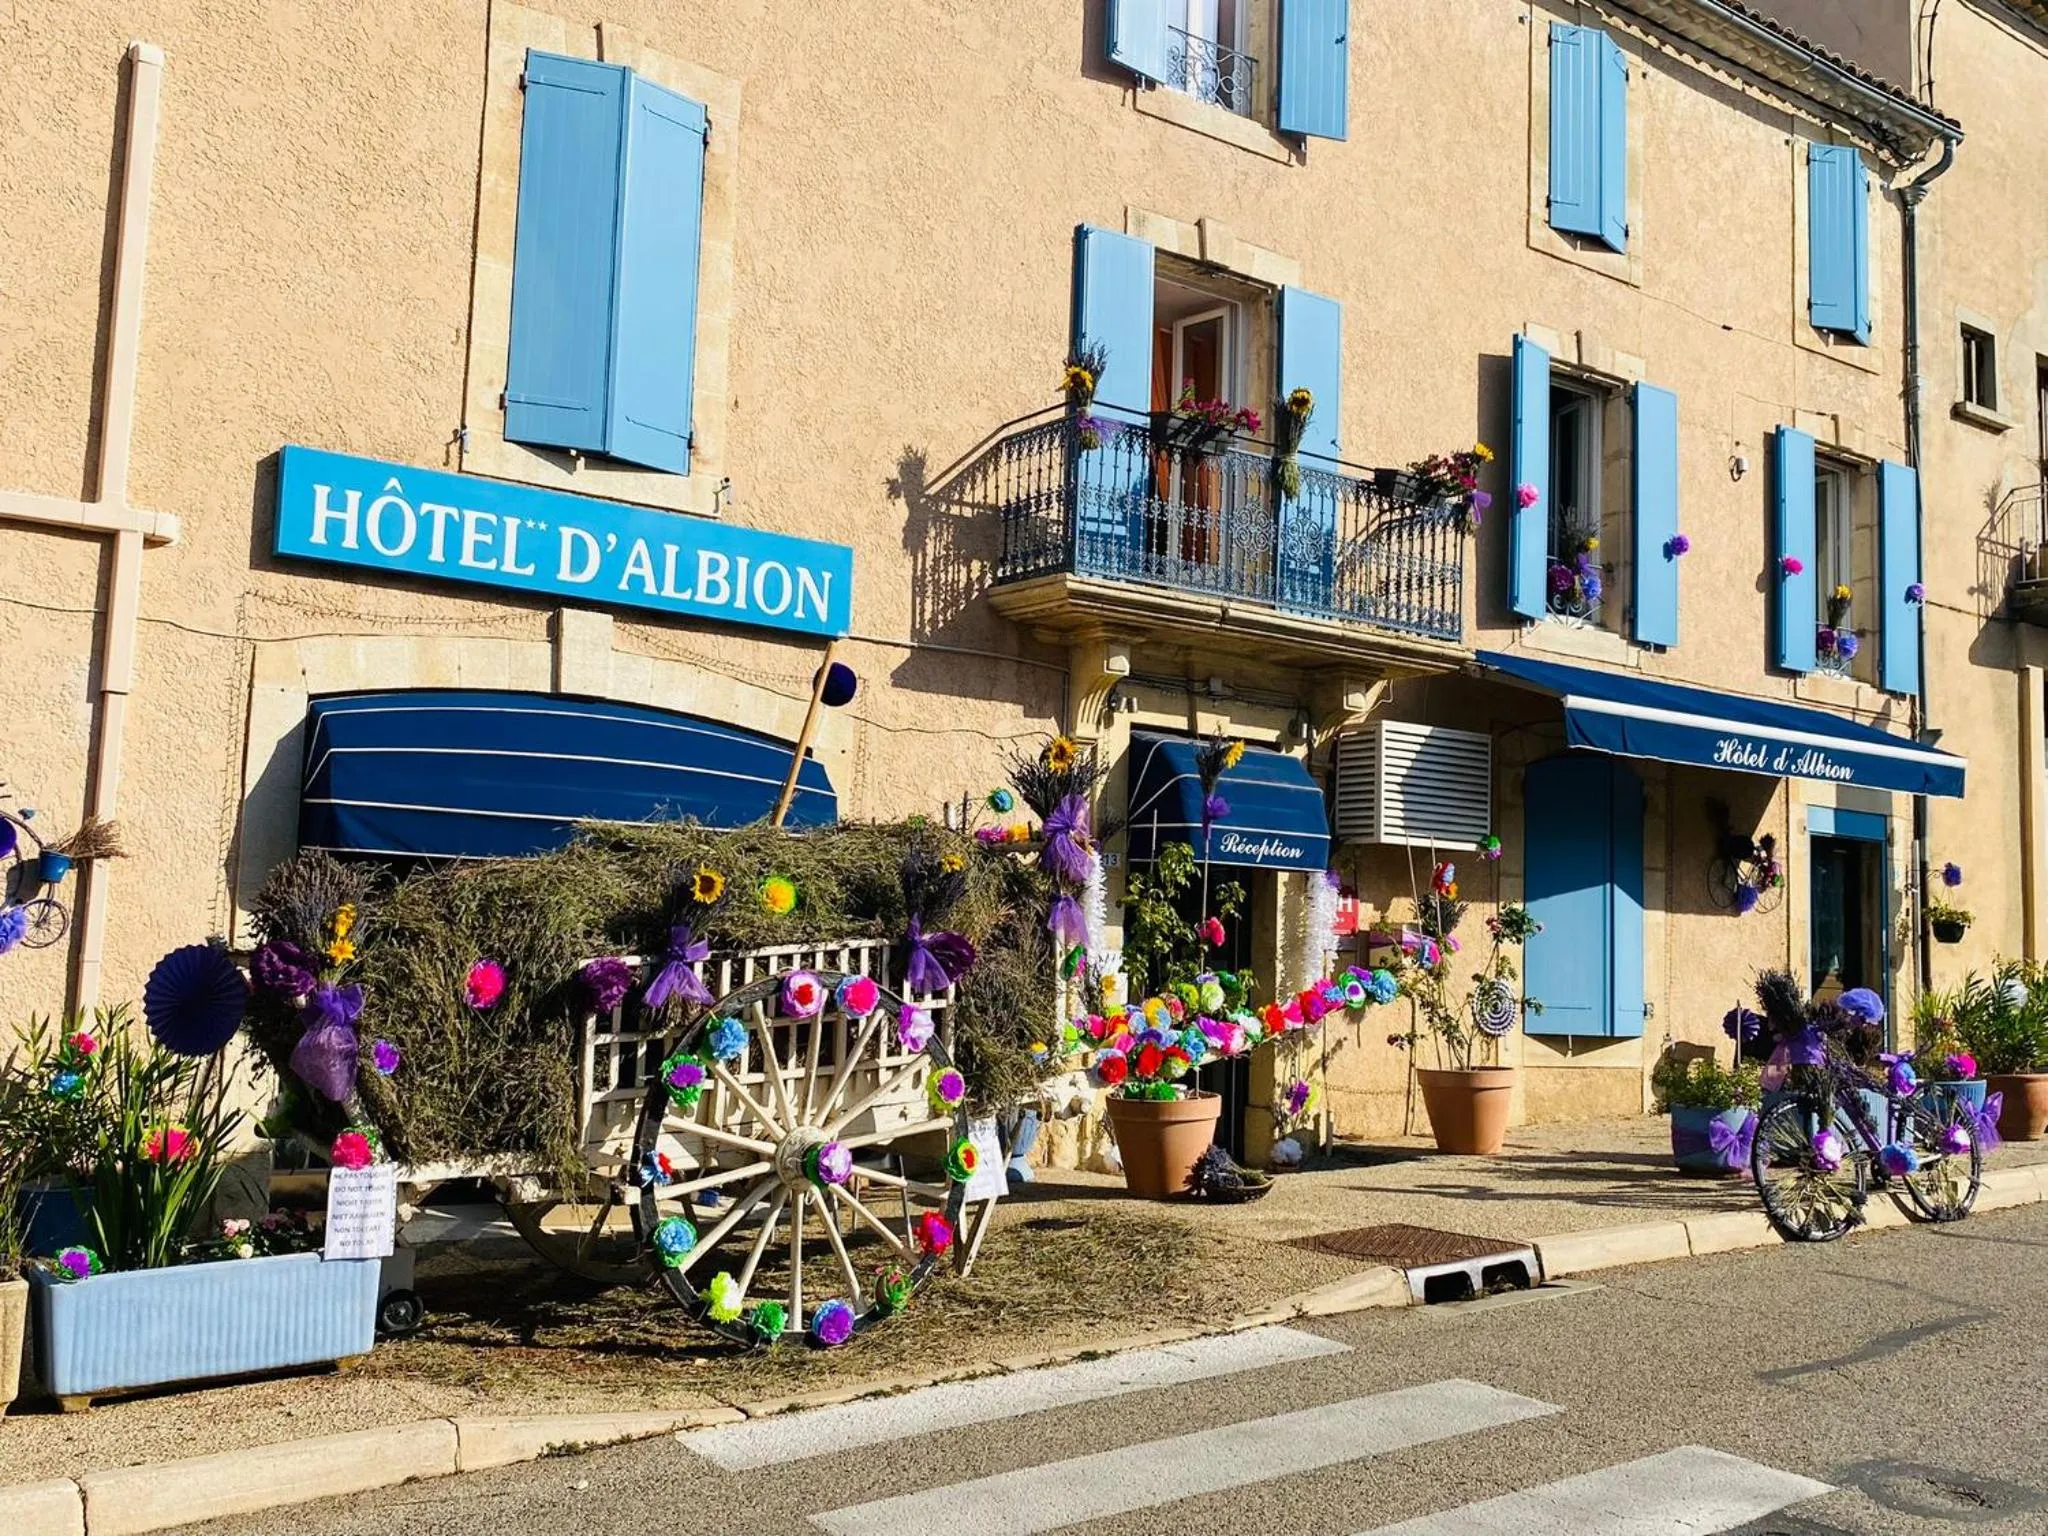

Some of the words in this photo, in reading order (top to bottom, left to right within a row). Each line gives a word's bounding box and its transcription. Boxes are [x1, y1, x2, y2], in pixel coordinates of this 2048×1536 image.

[309, 476, 536, 577] HÔTEL
[556, 525, 832, 623] D'ALBION
[1713, 738, 1769, 768] Hôtel
[1773, 747, 1854, 780] d'Albion
[1220, 832, 1304, 863] Réception
[1338, 895, 1353, 913] H
